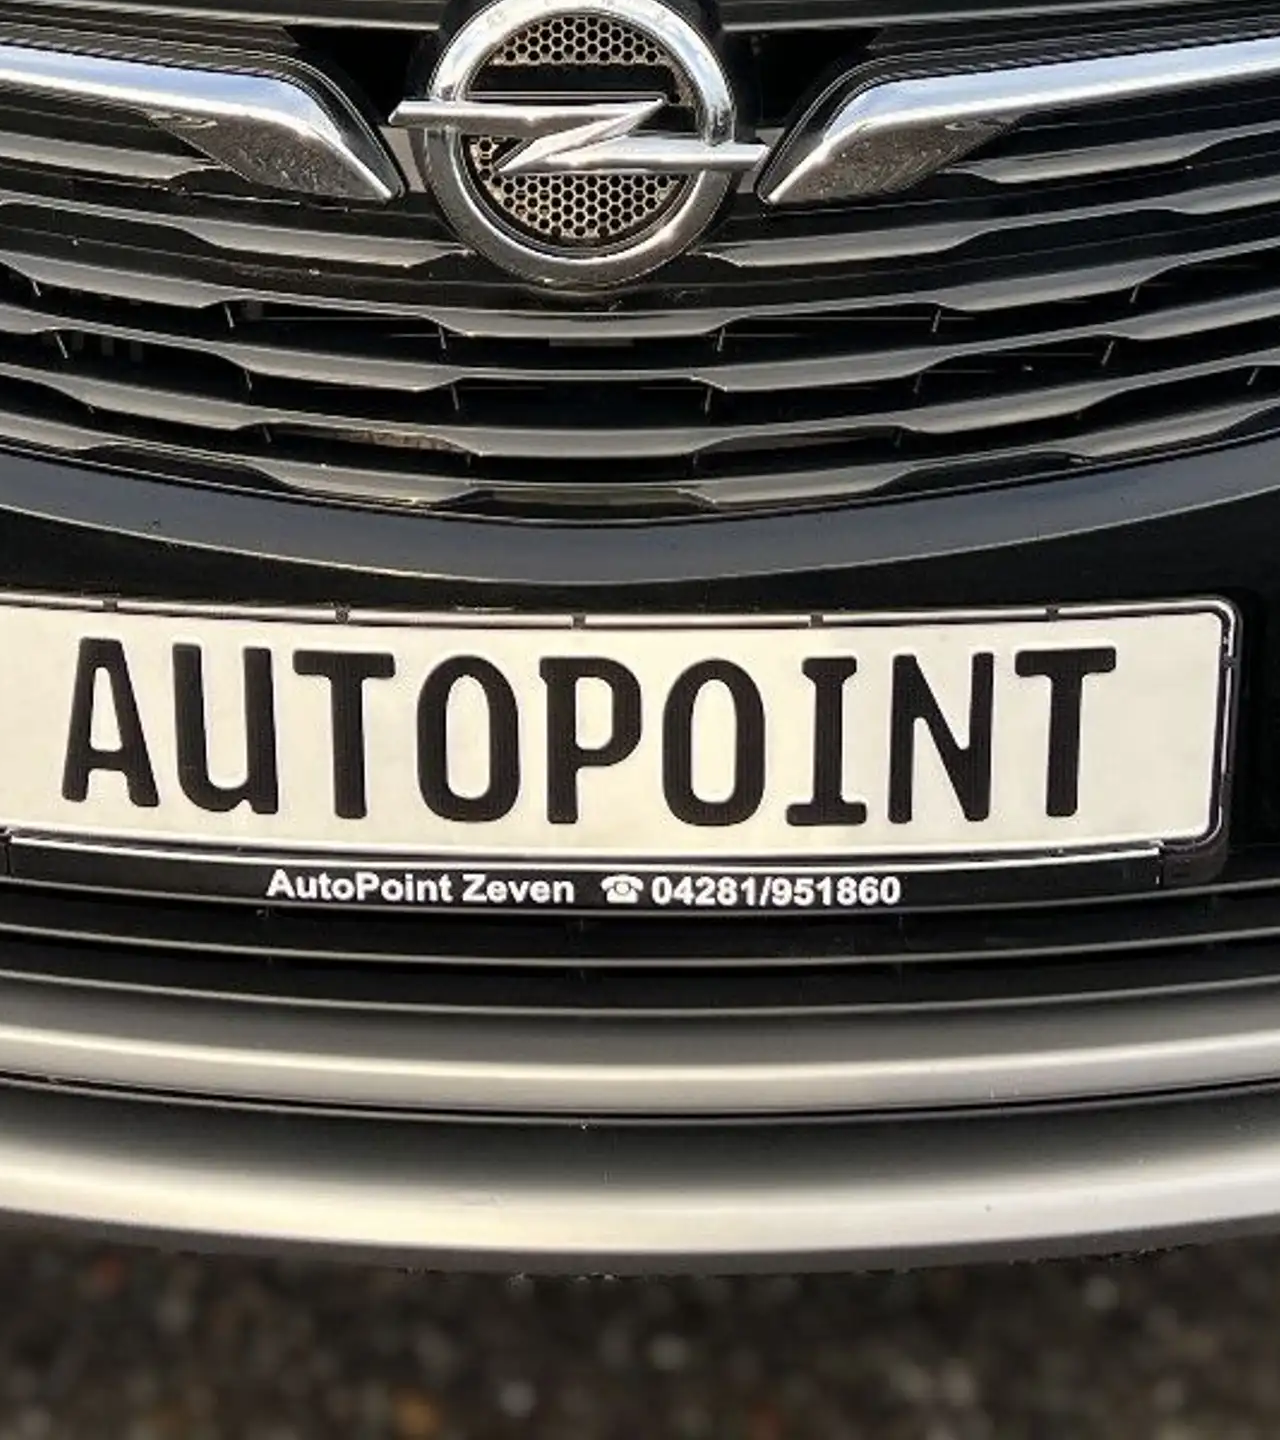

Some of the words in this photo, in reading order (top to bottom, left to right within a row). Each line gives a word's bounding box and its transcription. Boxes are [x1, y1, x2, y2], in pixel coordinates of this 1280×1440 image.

[62, 637, 1117, 828] AUTOPOINT
[265, 867, 454, 903] AutoPoint
[461, 872, 575, 904] Zeven
[651, 875, 901, 907] 04281/951860
